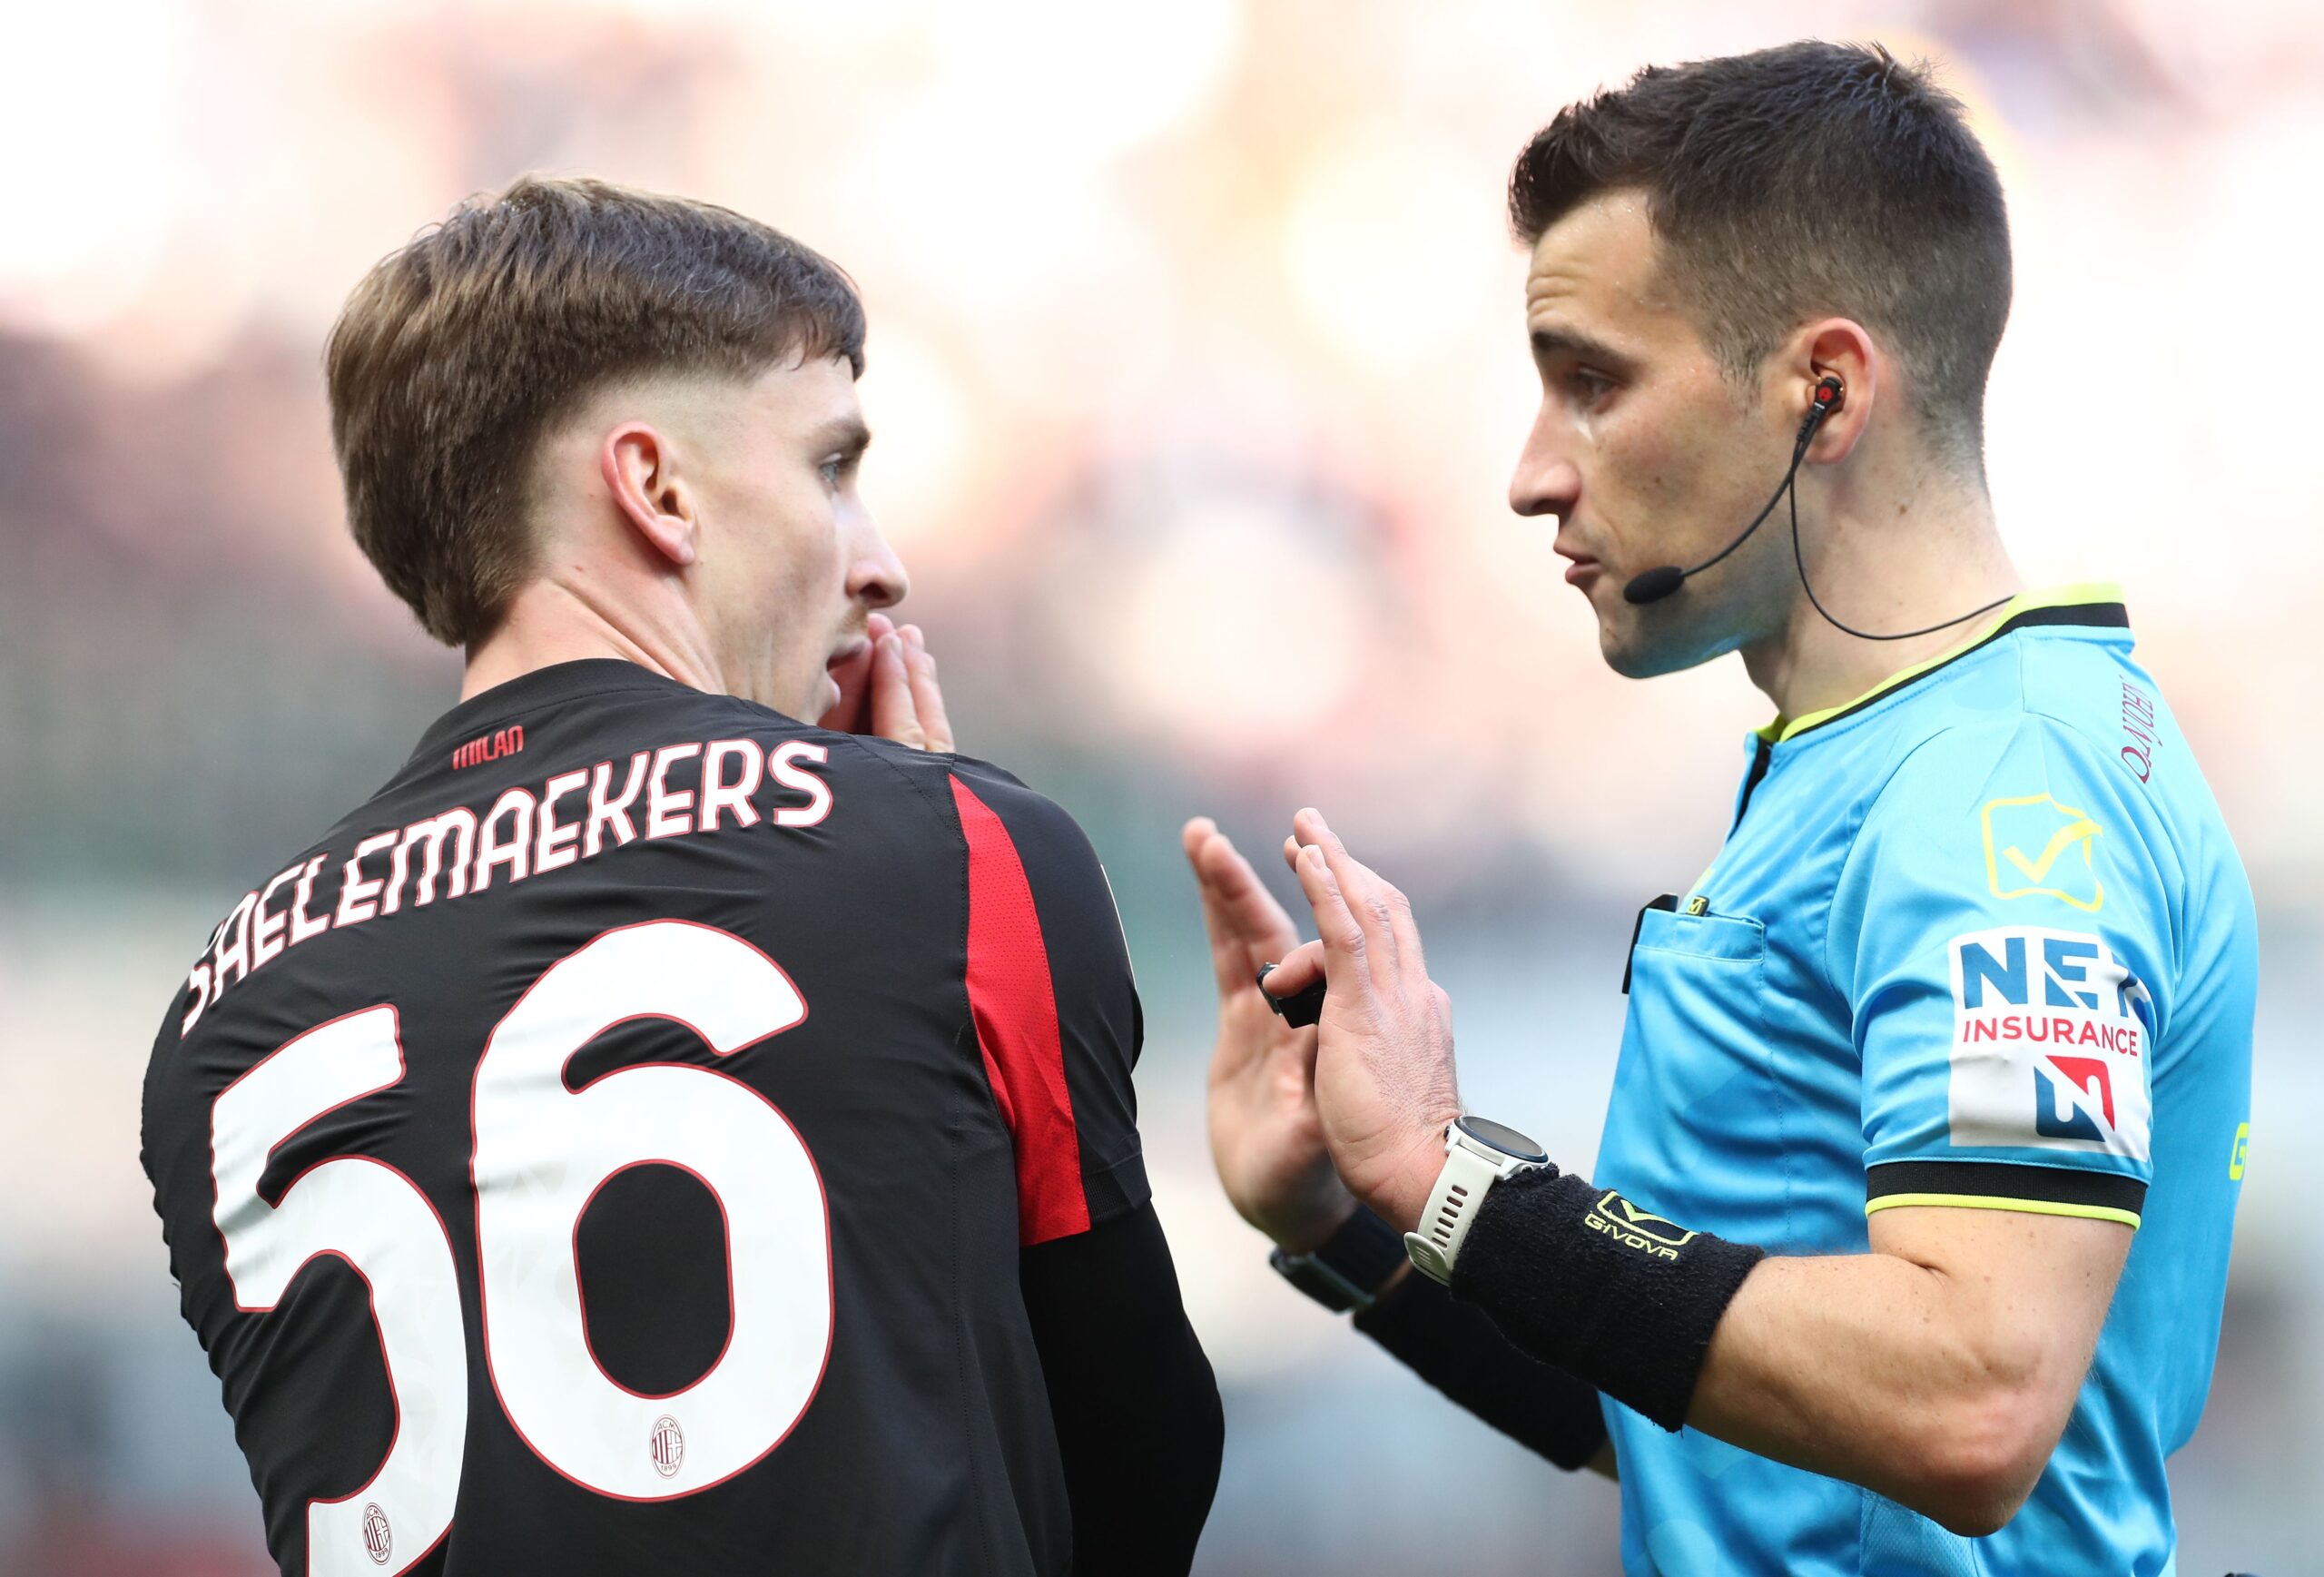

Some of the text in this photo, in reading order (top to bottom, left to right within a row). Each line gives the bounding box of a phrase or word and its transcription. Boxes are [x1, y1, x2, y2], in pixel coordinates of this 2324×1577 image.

[452, 724, 525, 771] MILAN
[181, 737, 833, 1039] SAELEMAEKERS
[1963, 1016, 2138, 1057] INSURANCE
[210, 918, 835, 1577] 56
[1584, 1213, 1679, 1261] GIVOVA
[660, 1463, 677, 1472] 1899
